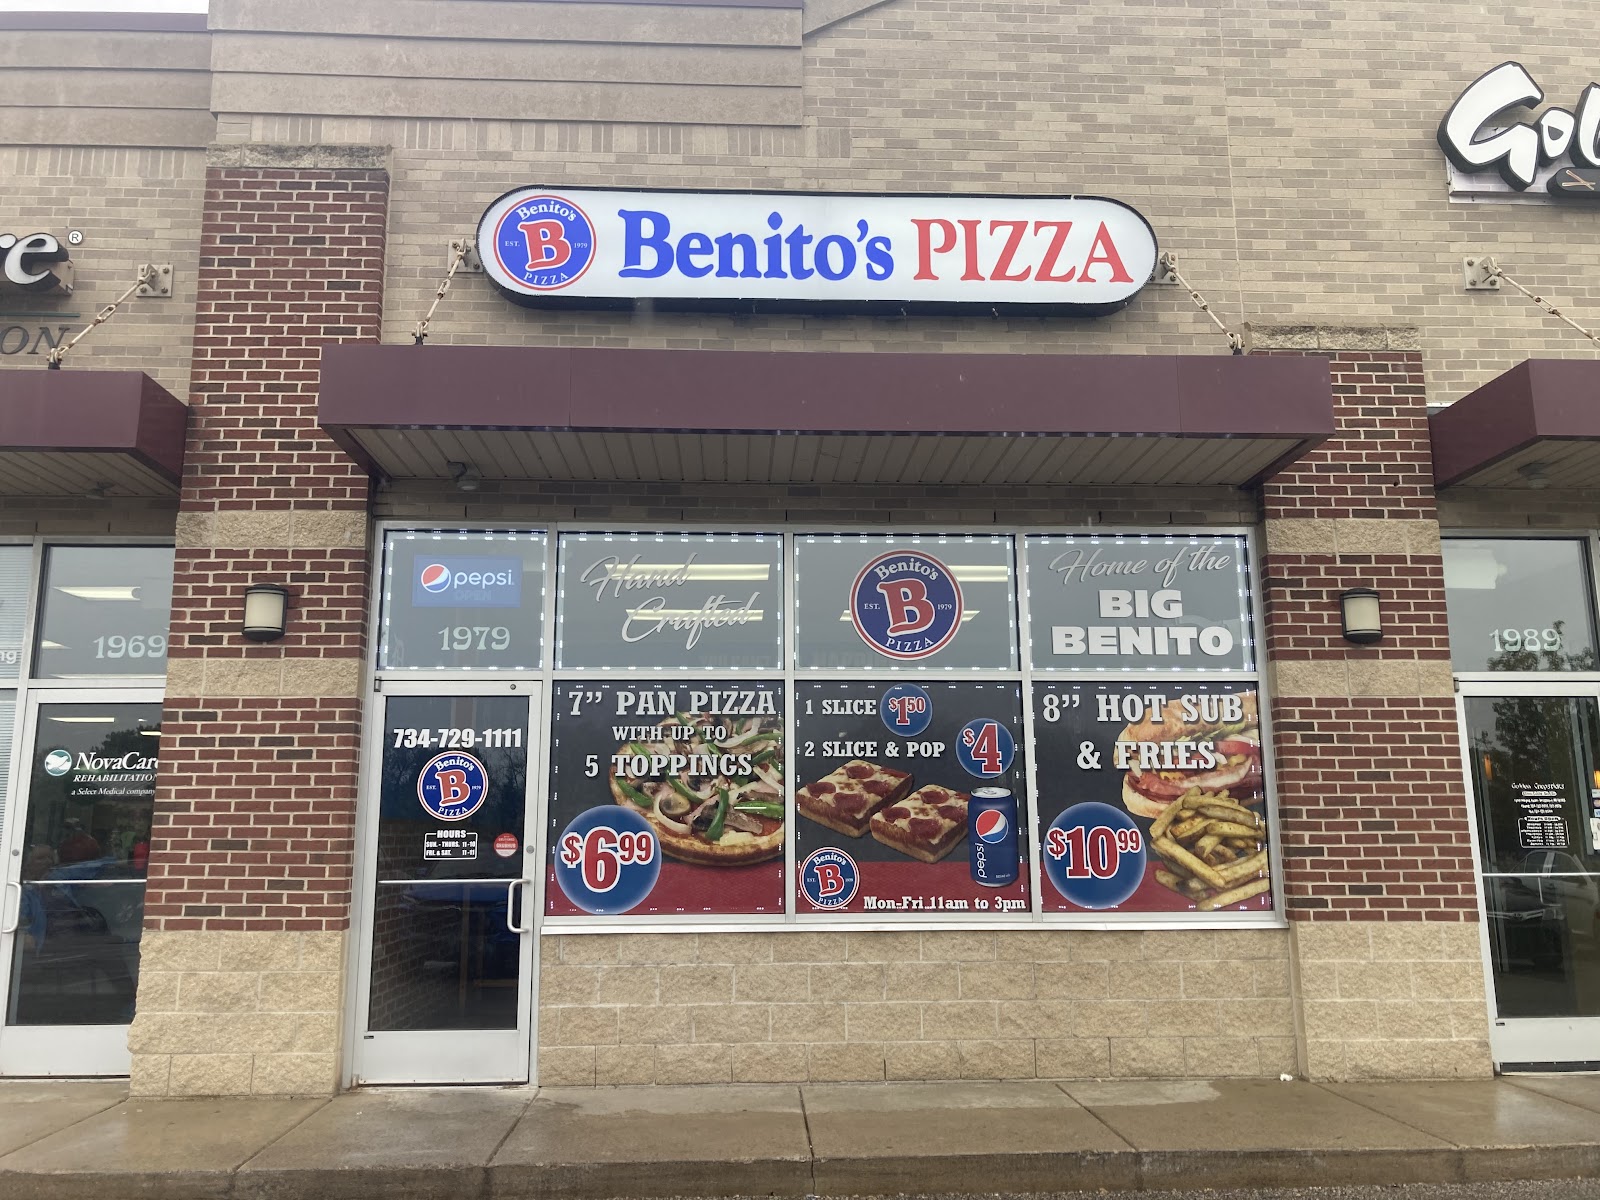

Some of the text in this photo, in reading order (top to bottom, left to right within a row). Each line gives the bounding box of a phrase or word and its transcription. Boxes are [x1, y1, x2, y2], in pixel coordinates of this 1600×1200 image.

[516, 201, 576, 221] Benito's
[517, 219, 571, 271] B
[618, 209, 1134, 283] Benito's PIZZA
[523, 272, 569, 285] PIZZA
[580, 552, 698, 602] Hand
[874, 558, 939, 580] Benito's
[1048, 546, 1231, 588] Home of the
[453, 569, 512, 589] pepsi
[876, 578, 935, 637] B
[1099, 590, 1183, 618] BIG
[621, 592, 760, 650] Crafted
[93, 635, 166, 659] 1969
[438, 627, 511, 650] 1979
[886, 637, 934, 652] PIZZA
[1051, 626, 1233, 655] BENITO
[1489, 628, 1561, 652] 1989
[616, 691, 676, 715] PAN
[690, 691, 776, 715] PIZZA
[806, 699, 877, 715] 1 SLICE
[1096, 694, 1166, 722] HOT
[1181, 694, 1243, 722] SUB
[393, 728, 521, 748] 734-729-1111
[612, 725, 727, 741] WITH UP TO
[804, 741, 945, 757] 2 SLICE & POP
[963, 723, 1002, 773] $4
[1076, 741, 1217, 770] & FRIES
[434, 757, 474, 771] Benito's
[584, 754, 752, 777] 5 TOPPINGS
[77, 787, 97, 795] Select
[98, 787, 125, 795] Medical
[435, 769, 470, 806] B
[438, 806, 469, 816] PIZZA
[437, 830, 466, 838] HOURS
[813, 853, 847, 865] Benito's
[975, 843, 987, 878] pepsi
[814, 864, 844, 897] B
[818, 897, 843, 905] PIZZA
[864, 896, 1026, 912] Mon-Fri 11am to 3pm
